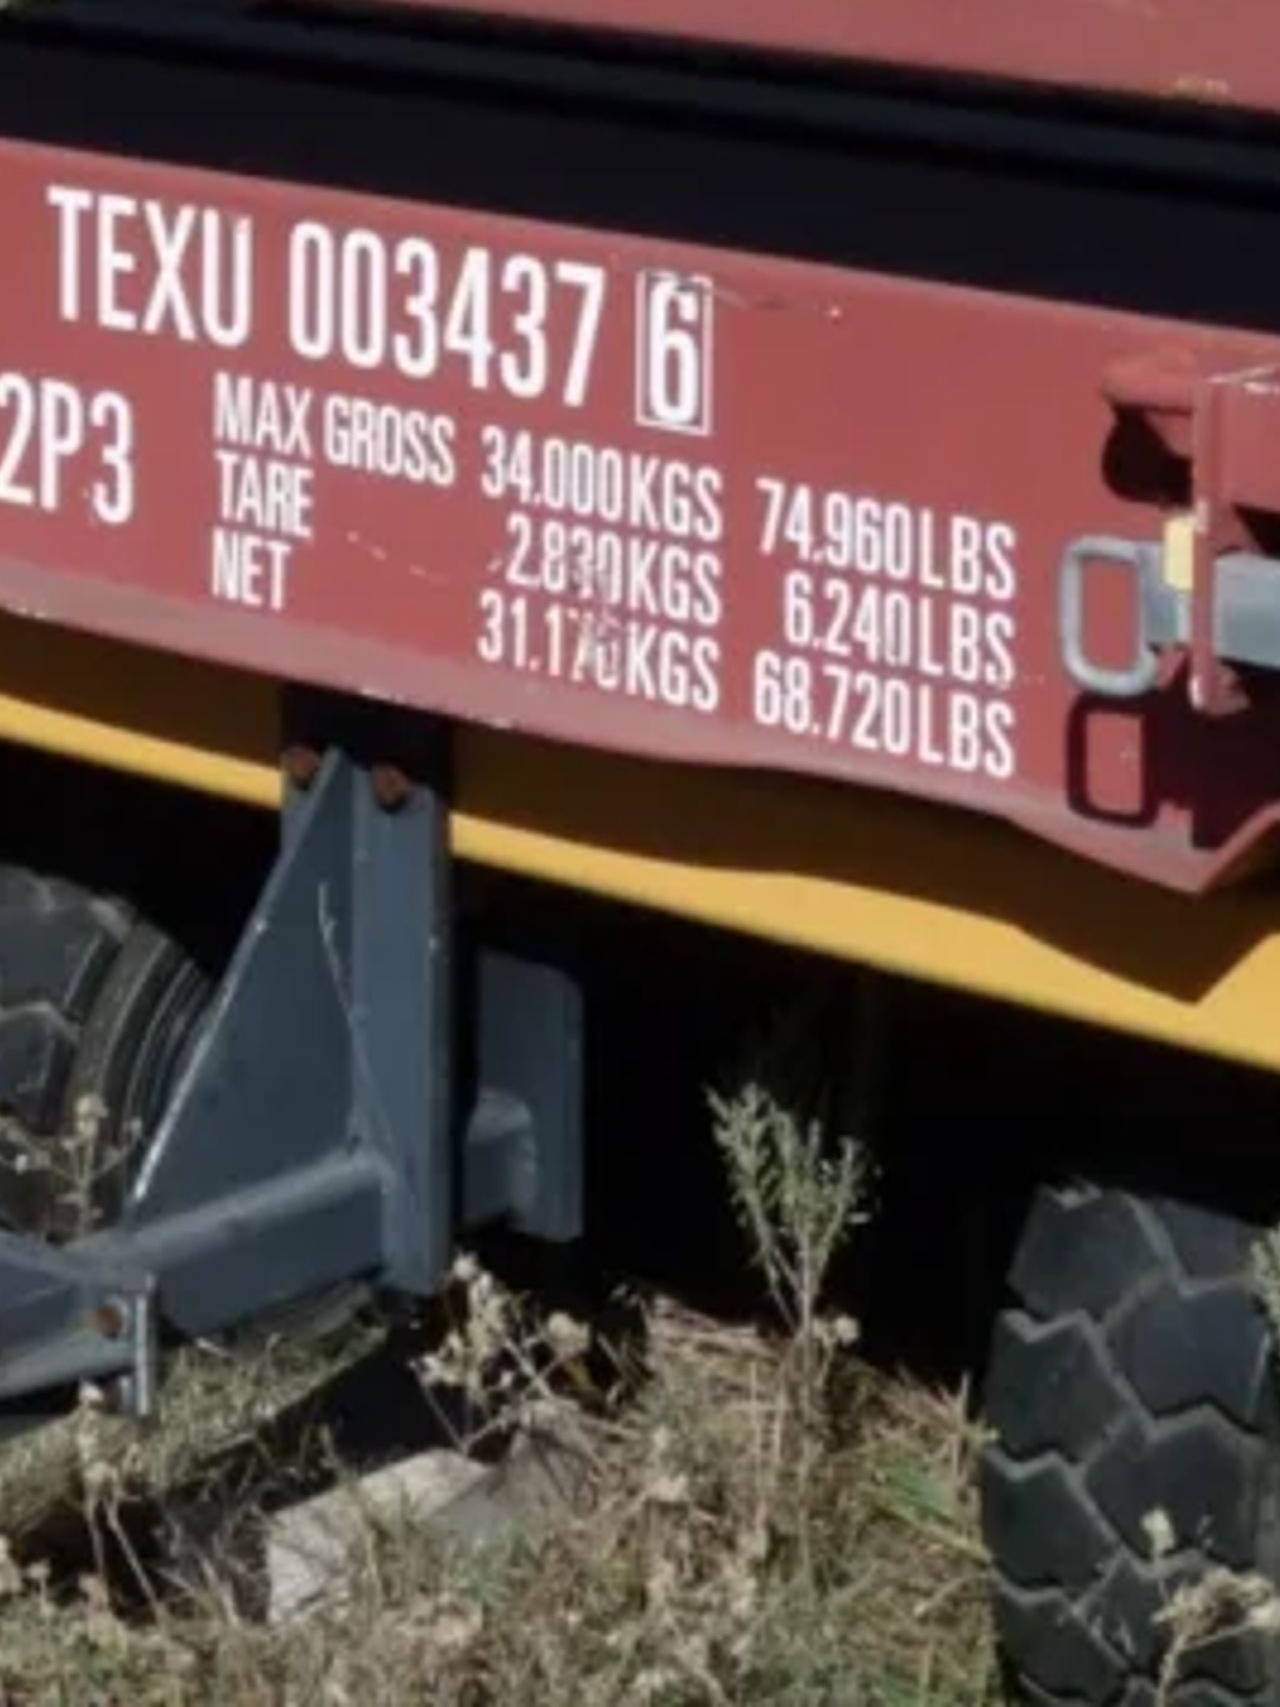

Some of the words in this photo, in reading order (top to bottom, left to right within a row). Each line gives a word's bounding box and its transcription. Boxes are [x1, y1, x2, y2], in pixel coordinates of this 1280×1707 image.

[47, 185, 252, 347] TEXU
[289, 220, 606, 408] 003437
[648, 275, 700, 425] 6
[214, 371, 312, 460] MAX
[324, 395, 456, 487] GROSS
[214, 449, 314, 541] TARE
[211, 525, 292, 612] NET
